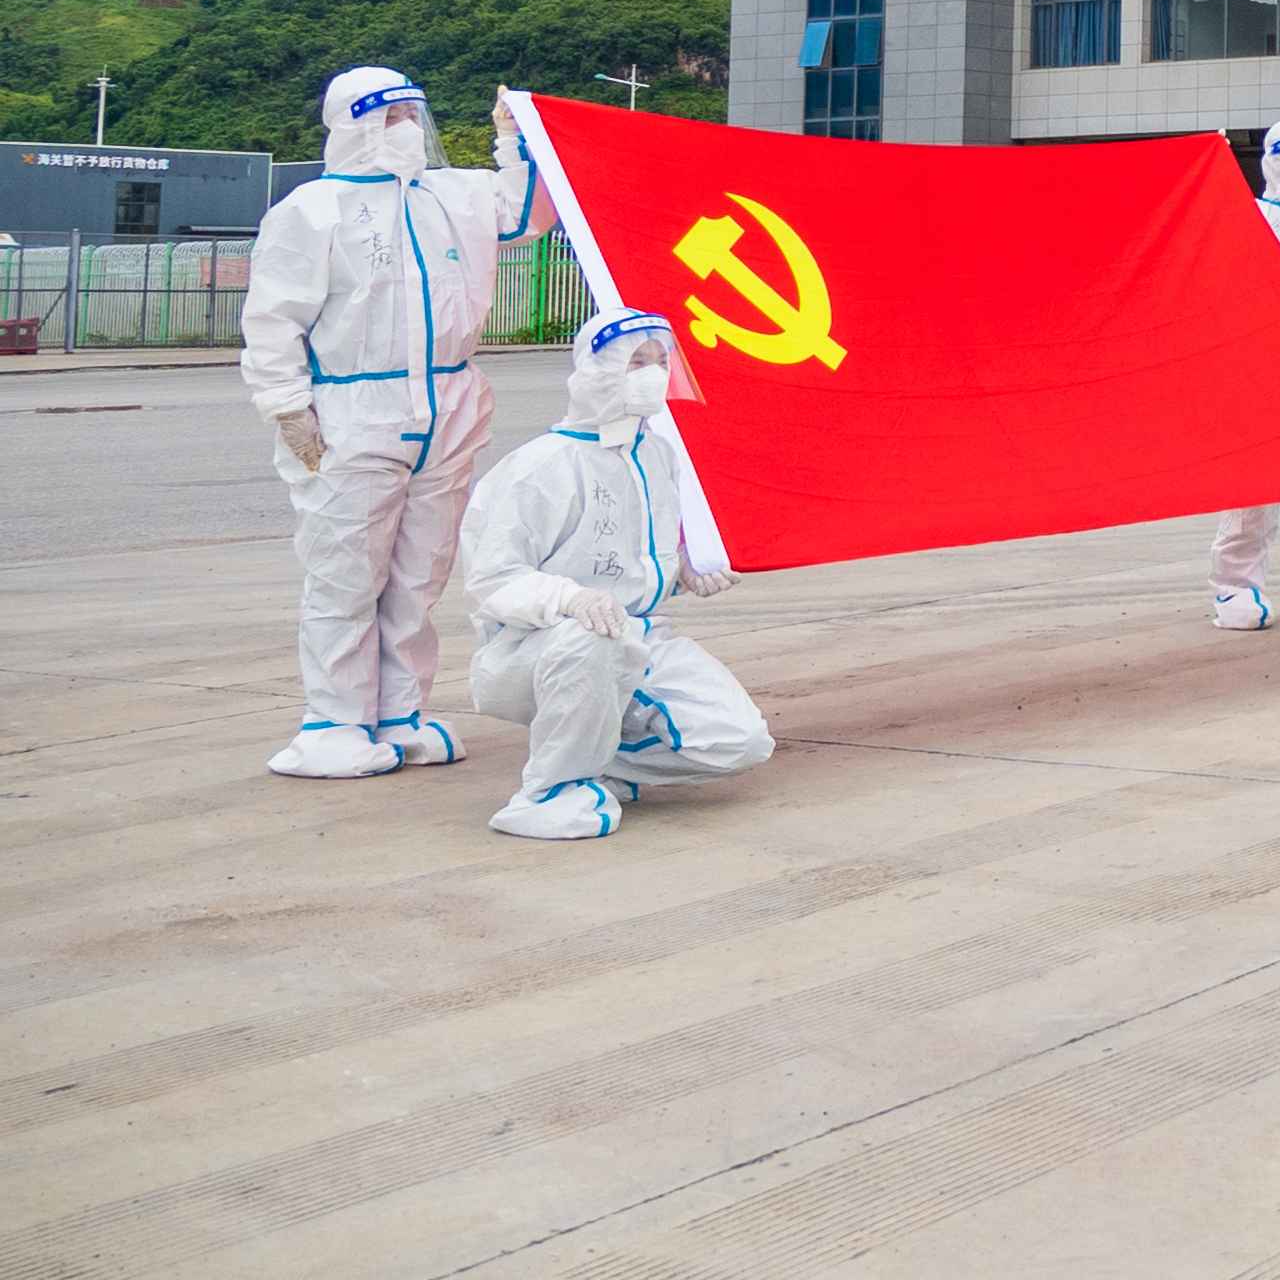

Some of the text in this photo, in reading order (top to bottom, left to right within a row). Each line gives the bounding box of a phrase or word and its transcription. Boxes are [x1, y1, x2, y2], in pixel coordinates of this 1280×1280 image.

[37, 153, 170, 170] 海关暂不予放行货物仓库
